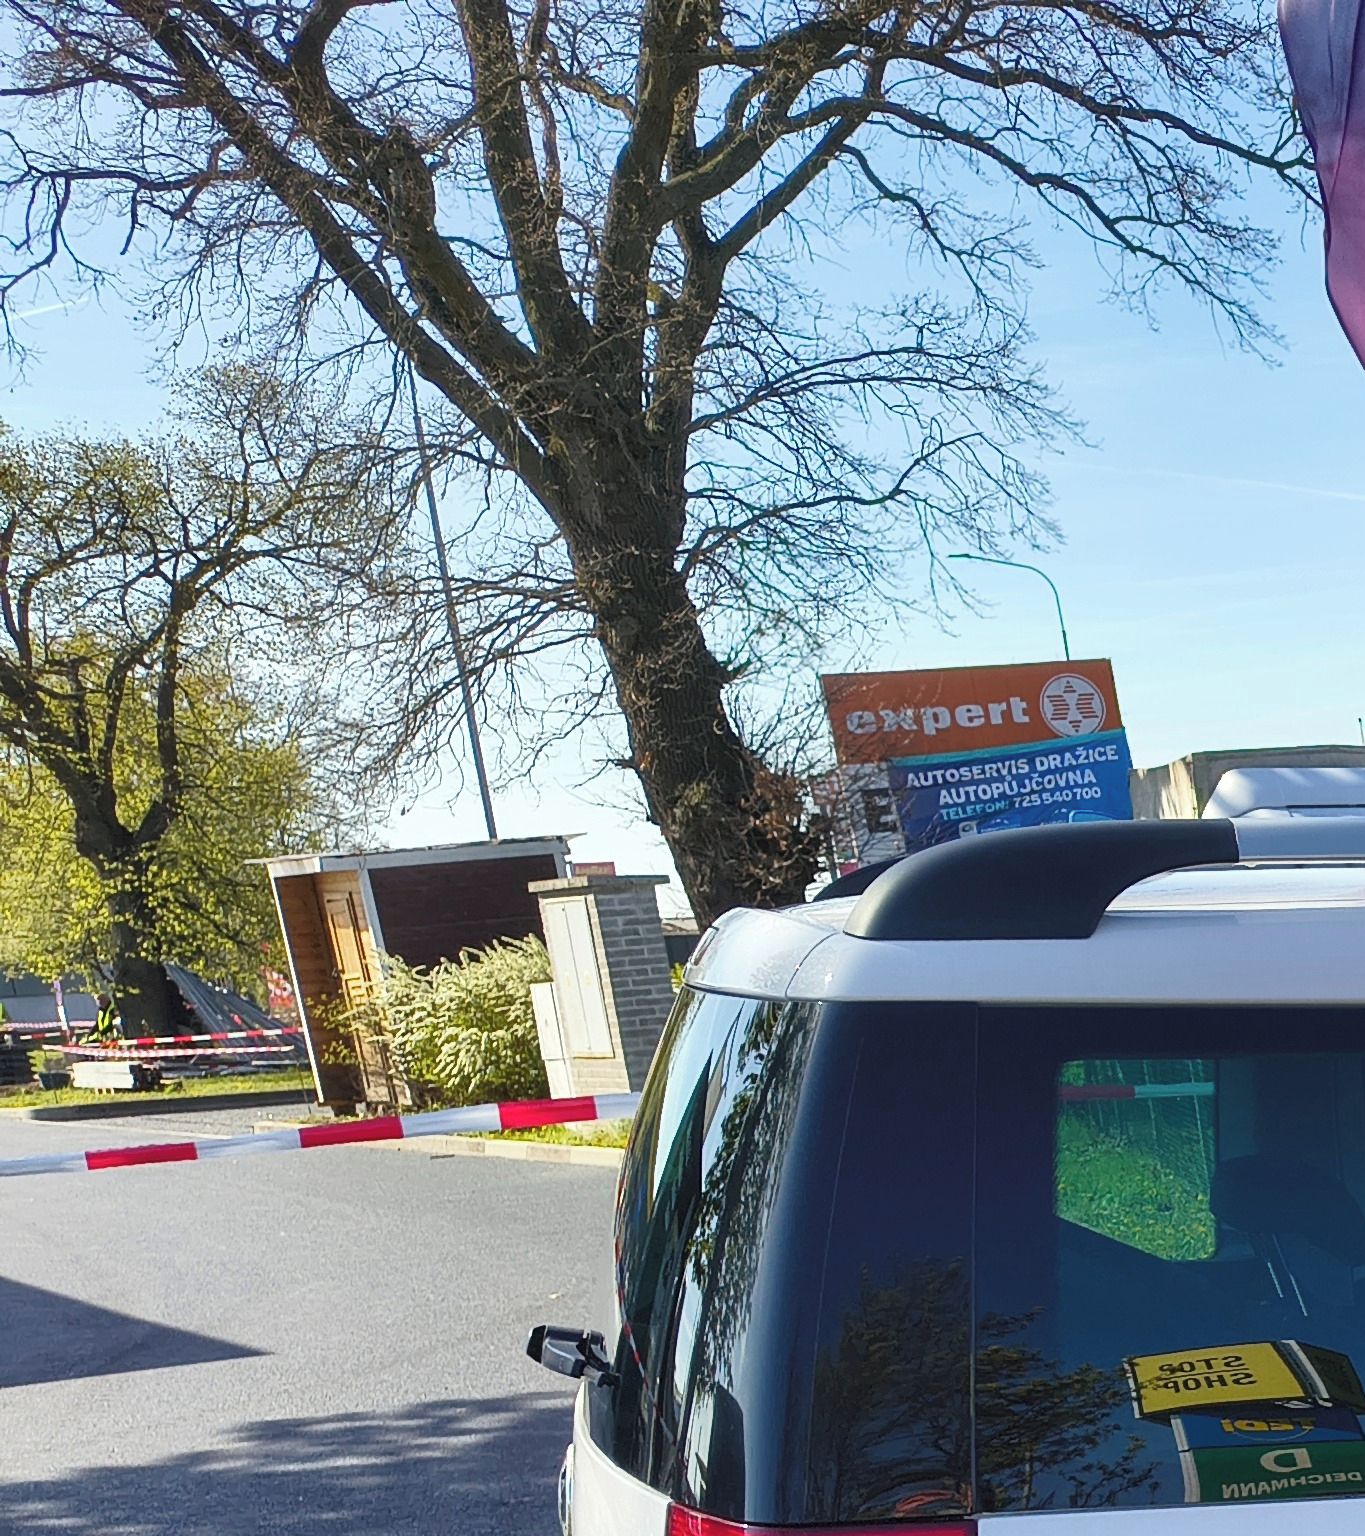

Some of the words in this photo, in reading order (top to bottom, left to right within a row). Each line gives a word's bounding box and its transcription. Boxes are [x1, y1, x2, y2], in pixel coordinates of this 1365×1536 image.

[846, 696, 1029, 736] expert
[906, 759, 1029, 788] AUTOSERVIS
[1035, 745, 1119, 772] DRAŽICE
[939, 769, 1097, 806] AUTOPŮJČOVNA
